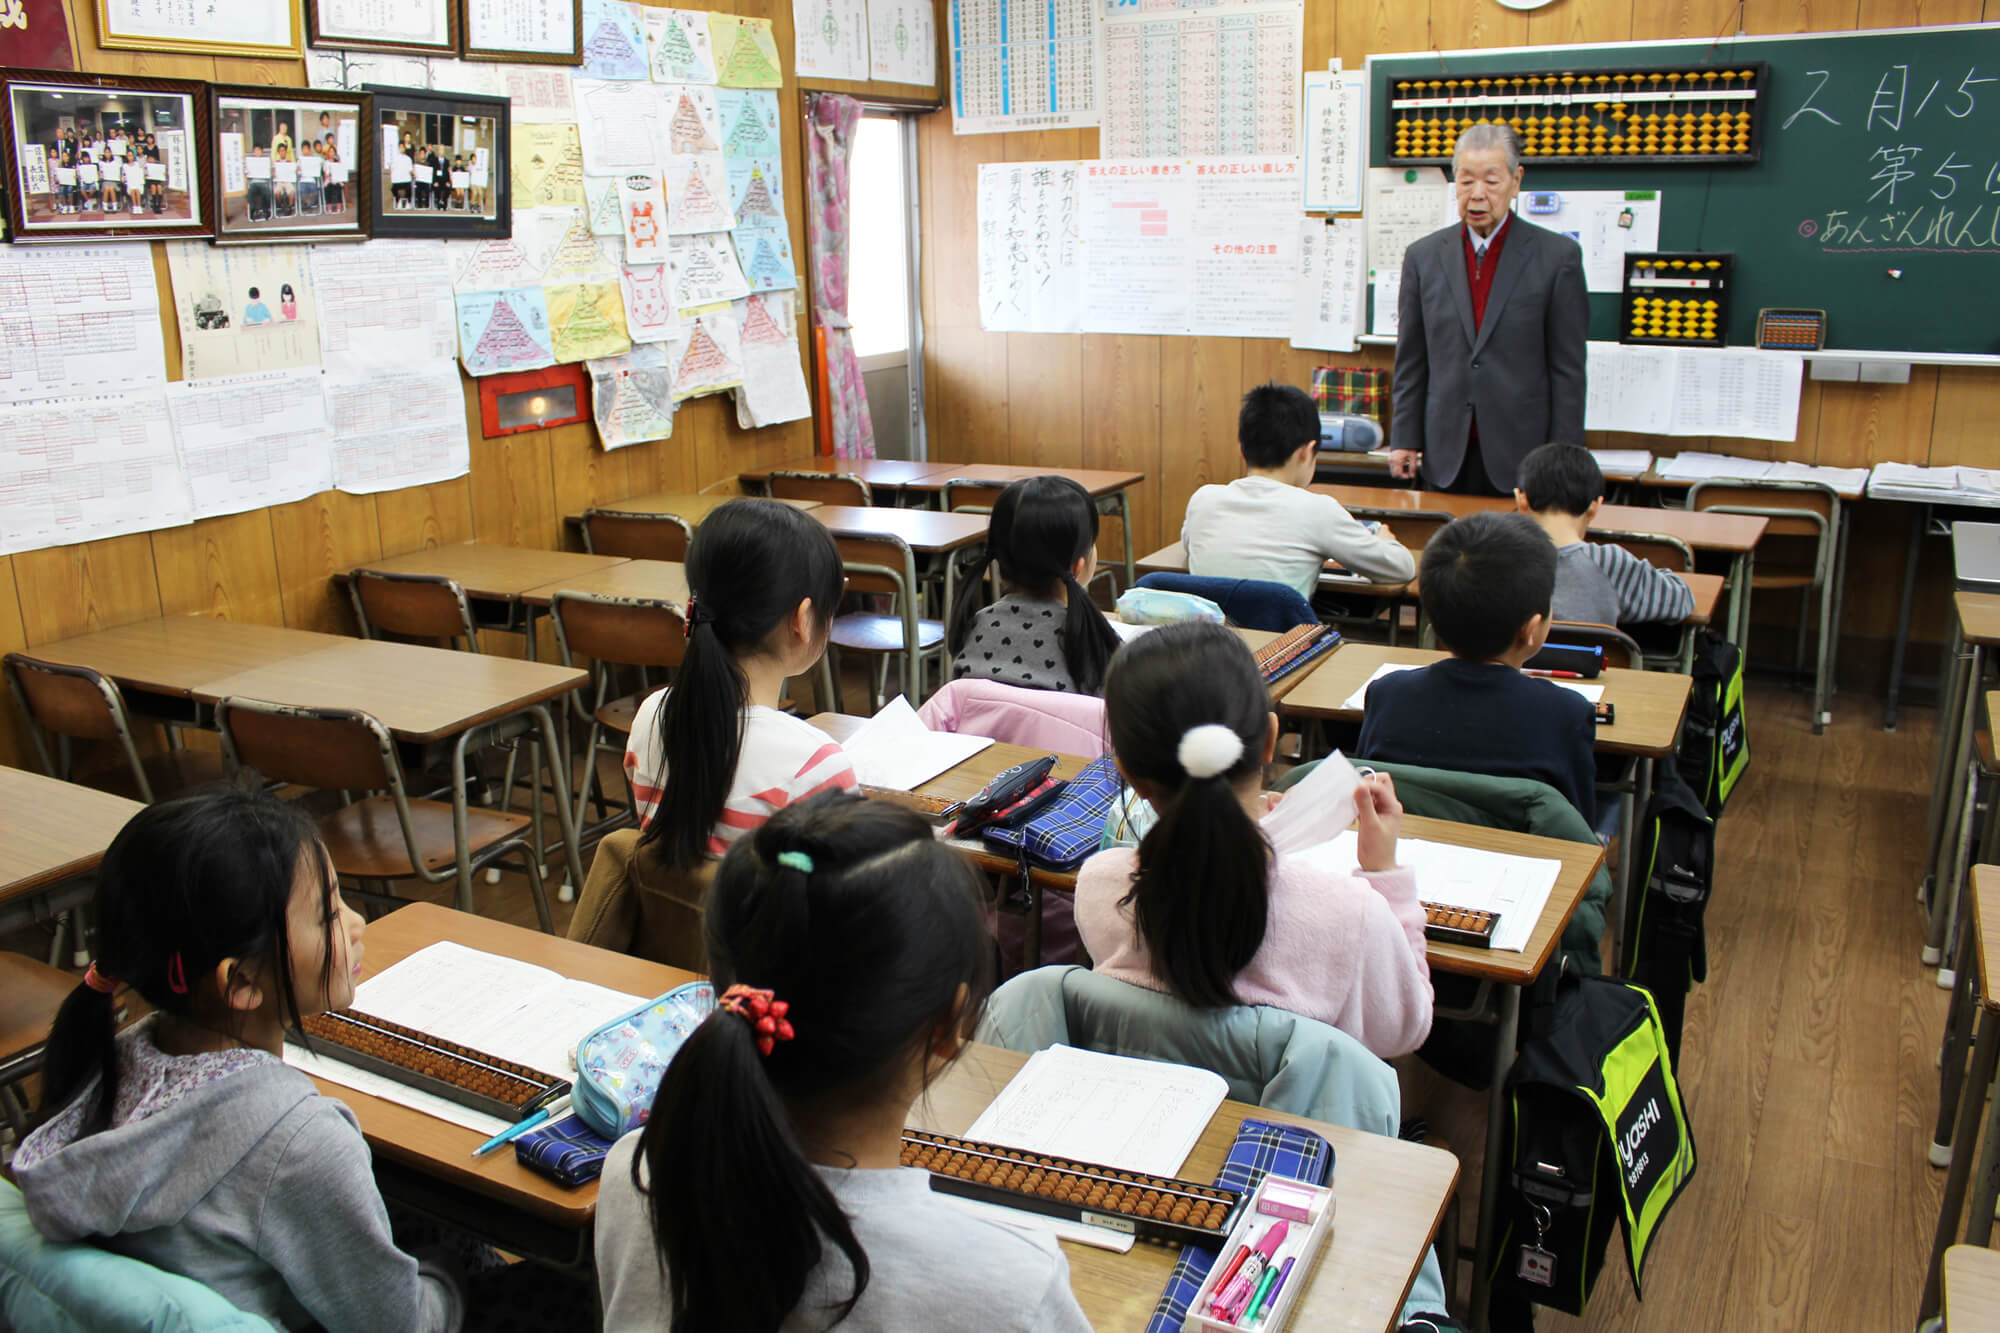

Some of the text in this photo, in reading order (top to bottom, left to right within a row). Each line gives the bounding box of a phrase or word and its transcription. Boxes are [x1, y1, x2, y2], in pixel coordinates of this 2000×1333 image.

[1329, 80, 1342, 90] 15
[1088, 165, 1181, 176] 答えの正しい書き方
[1197, 163, 1296, 175] 答えの正しい直し方
[1213, 244, 1278, 255] その他の注意
